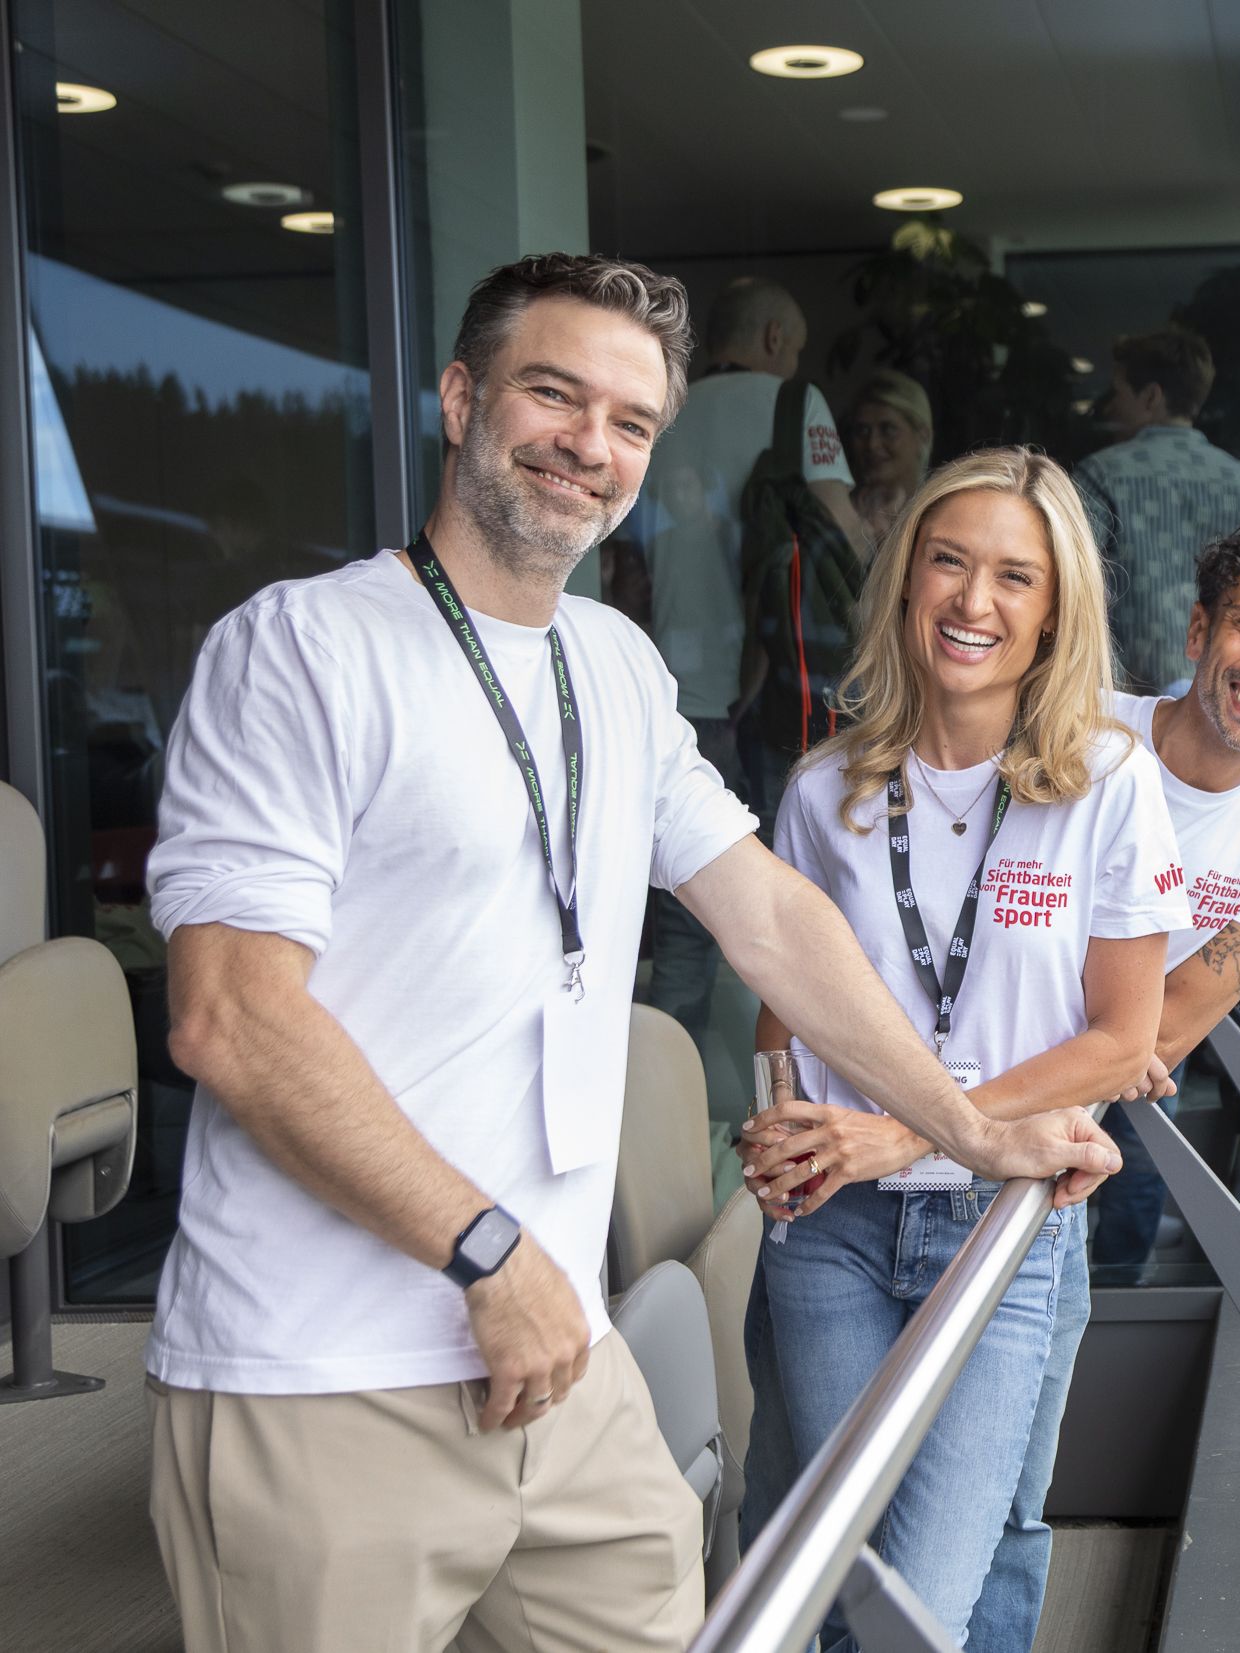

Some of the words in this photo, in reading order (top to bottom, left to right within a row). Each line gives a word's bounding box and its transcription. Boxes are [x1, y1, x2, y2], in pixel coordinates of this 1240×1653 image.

[435, 582, 464, 620] MORE
[459, 622, 482, 660] THAN
[478, 662, 506, 708] EQUAL
[557, 659, 570, 699] MORE
[570, 752, 578, 799] EQUAL
[526, 766, 543, 812] MORE
[998, 858, 1014, 868] Für
[1016, 859, 1043, 870] mehr
[986, 869, 1073, 888] Sichtbarkeit
[1207, 869, 1222, 881] Für
[896, 891, 904, 903] DAY
[906, 887, 916, 908] EQUAL
[996, 884, 1068, 908] Frauen
[992, 907, 1052, 929] sport
[1192, 914, 1232, 931] spor
[912, 948, 920, 961] DAY
[922, 945, 933, 966] EQUAL
[949, 936, 959, 956] EQUAL
[961, 946, 969, 958] DAY
[951, 1076, 968, 1085] NG
